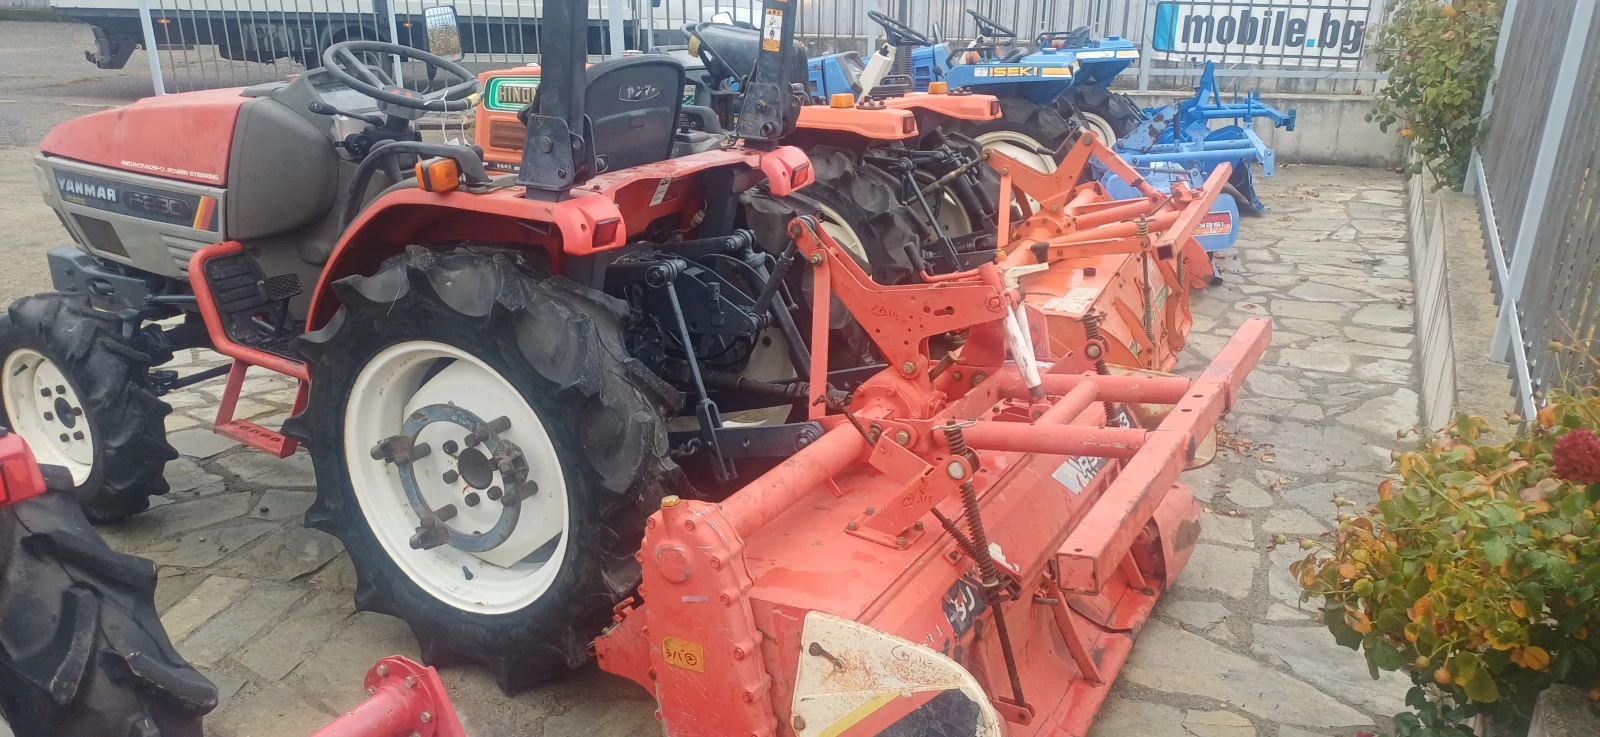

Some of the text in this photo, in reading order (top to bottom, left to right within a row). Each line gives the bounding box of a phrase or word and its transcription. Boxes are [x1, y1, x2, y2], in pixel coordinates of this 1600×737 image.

[1181, 9, 1365, 54] mobile.bg
[989, 66, 1038, 77] ISEKI
[626, 84, 656, 98] ヤンマー
[167, 167, 189, 177] POWER
[189, 170, 219, 181] STEERING
[57, 177, 117, 202] YANMAR
